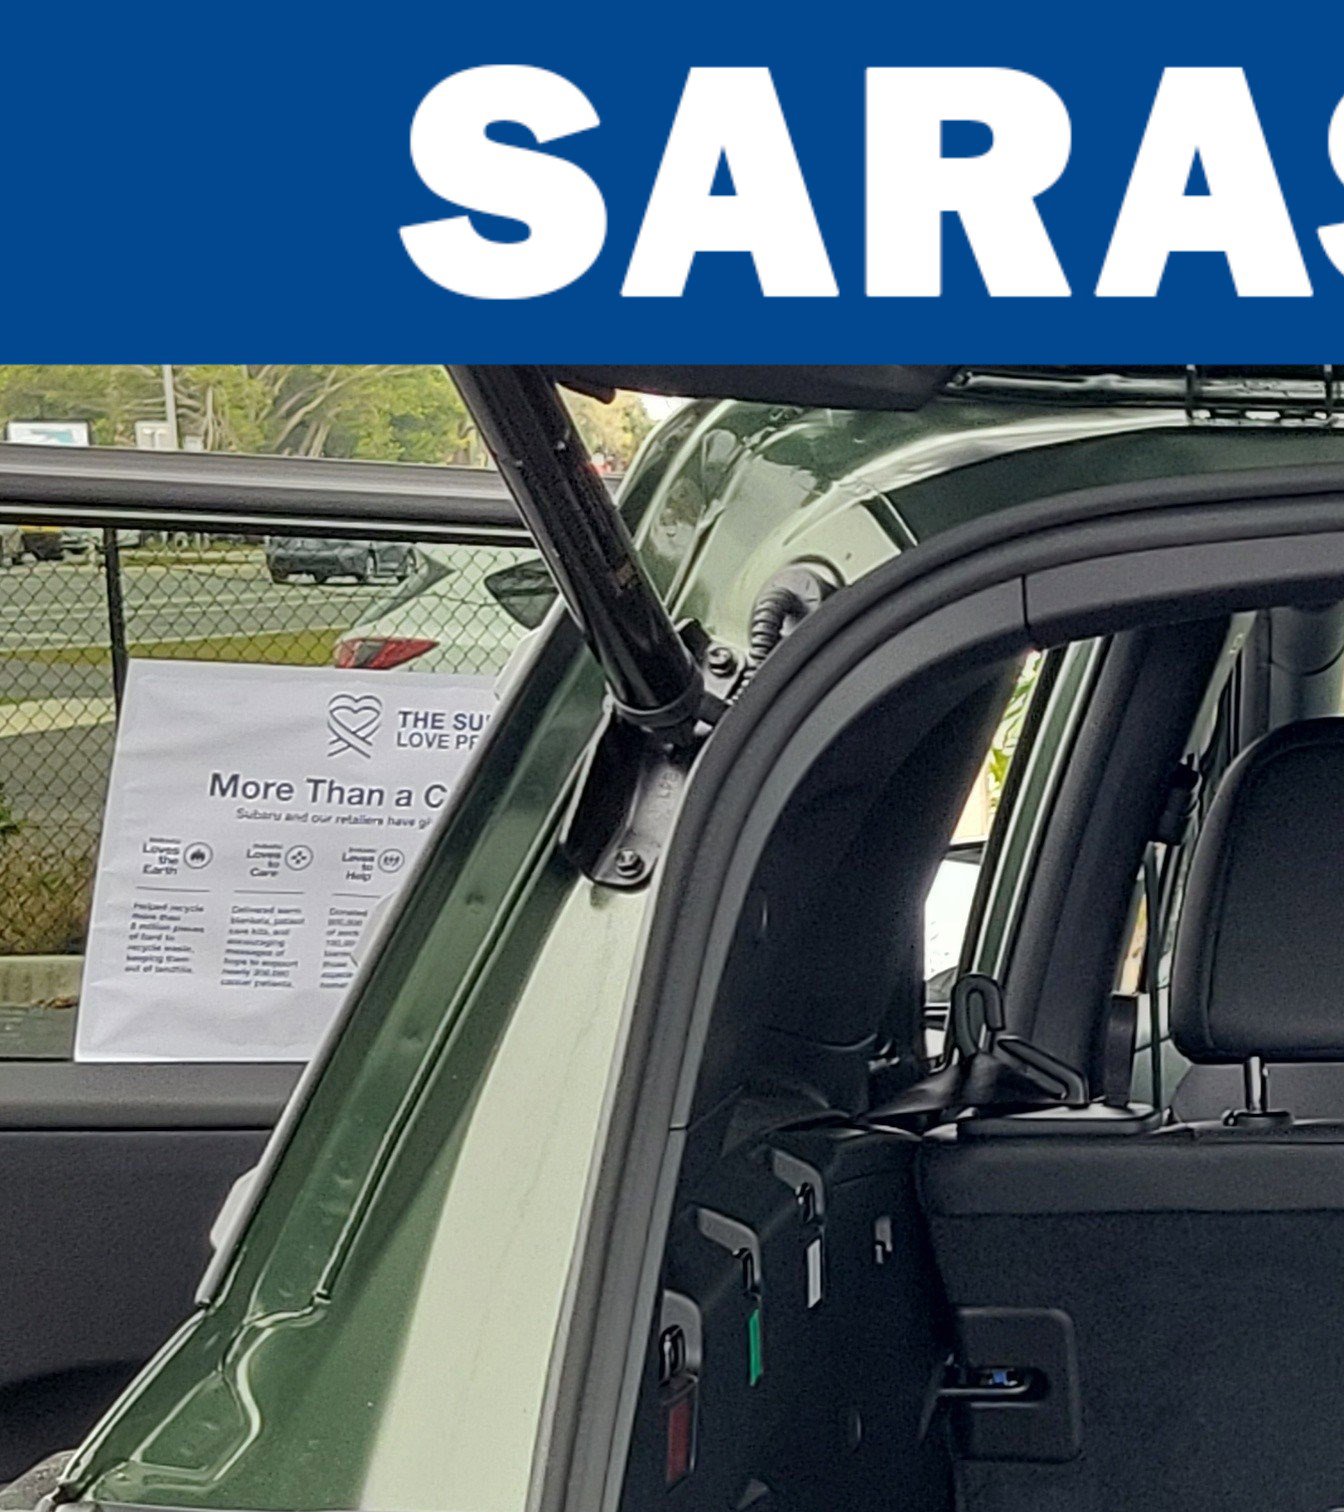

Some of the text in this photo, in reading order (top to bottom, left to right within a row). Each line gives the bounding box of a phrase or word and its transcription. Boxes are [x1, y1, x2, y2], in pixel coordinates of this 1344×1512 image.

[398, 711, 446, 730] THE
[396, 731, 450, 750] LOVE
[209, 773, 295, 802] More
[306, 778, 385, 807] Than
[395, 790, 413, 808] a
[236, 807, 282, 822] Subaru
[284, 812, 307, 823] and
[311, 814, 333, 824] our
[335, 814, 384, 826] retailers
[387, 816, 416, 827] have
[142, 842, 180, 855] Loves
[246, 849, 281, 859] Loves
[158, 855, 179, 864] the
[342, 853, 375, 863] Loves
[142, 863, 178, 875] Earth
[250, 867, 278, 877] Care
[346, 871, 371, 882] Help
